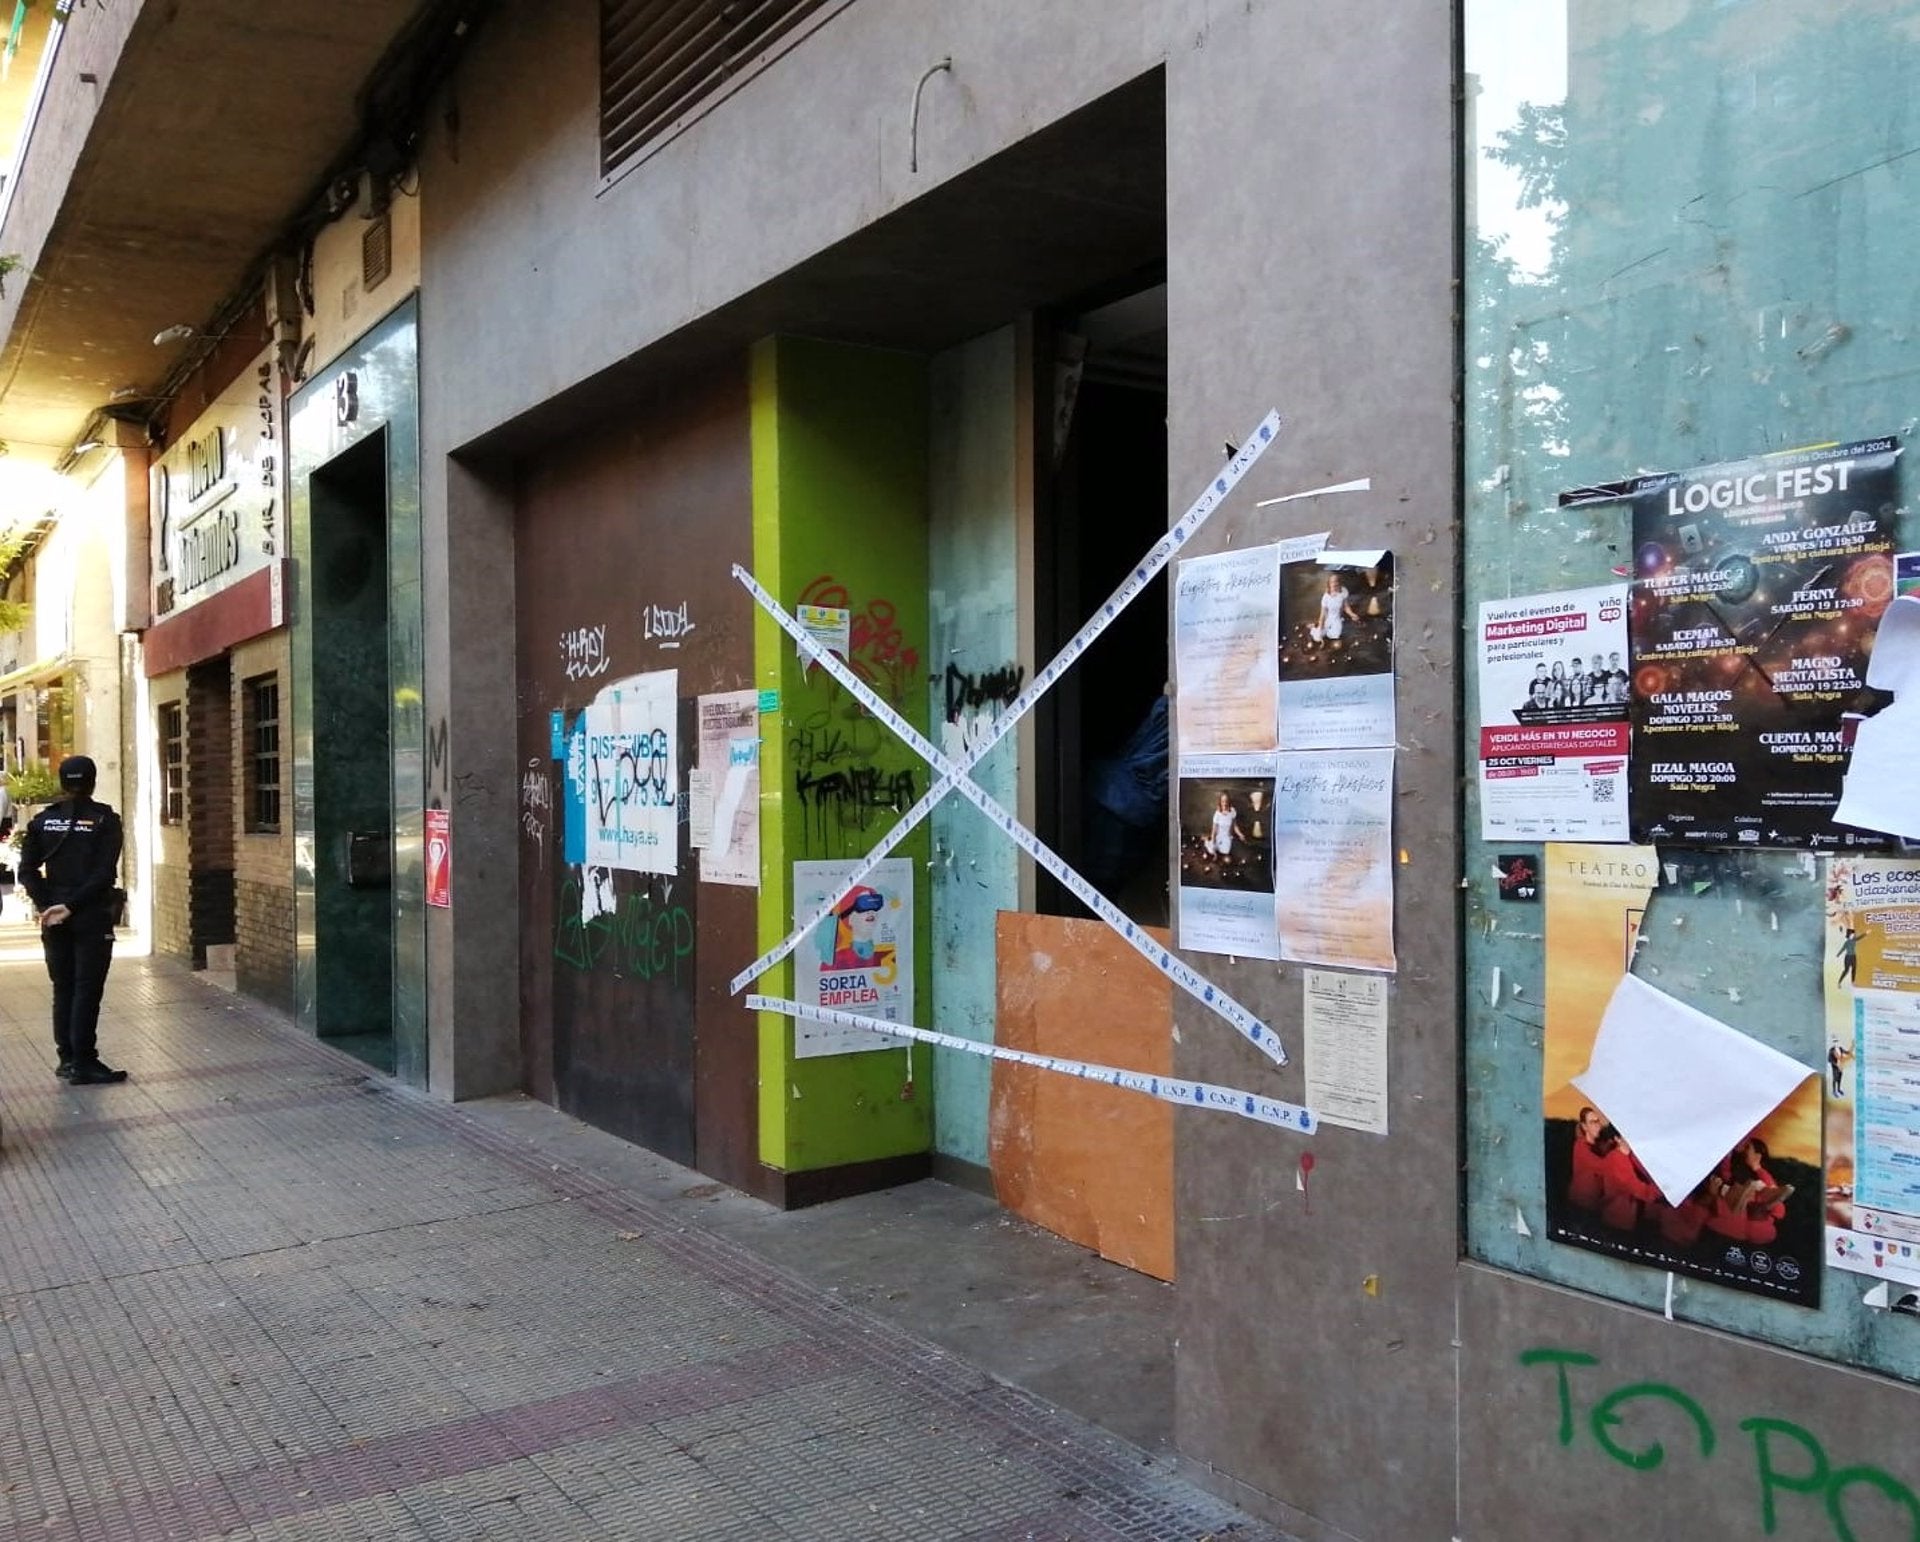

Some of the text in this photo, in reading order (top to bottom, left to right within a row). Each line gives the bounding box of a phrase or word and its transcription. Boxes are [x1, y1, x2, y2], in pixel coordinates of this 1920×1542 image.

[1811, 445, 1850, 463] Octubre
[1850, 443, 1865, 456] del
[1865, 440, 1893, 455] 2024
[1667, 474, 1768, 516] LOGIC
[1776, 460, 1856, 500] FEST
[1762, 530, 1800, 546] ANDY
[1773, 535, 1866, 554] VIERNES 18 19:30
[1864, 541, 1891, 553] Rioja
[1643, 574, 1689, 588] TUPPER
[1690, 569, 1734, 583] MAGIC
[1653, 585, 1691, 597] VIERNES
[1693, 583, 1705, 593] 18
[1791, 587, 1838, 603] FERNY
[1817, 600, 1831, 610] 19
[1834, 598, 1864, 610] 17:30
[1487, 602, 1576, 621] Vuelve el evento de
[1791, 610, 1843, 621] Sala Negra
[1486, 615, 1585, 638] Marketing Digital
[1672, 627, 1720, 641] ICEMAN
[1487, 643, 1507, 653] para
[1507, 637, 1559, 651] particulares
[1709, 637, 1737, 648] 19:30
[1487, 650, 1545, 664] profesionales
[1791, 656, 1842, 670] MAGNO
[1772, 667, 1856, 683] MENTALISTA
[1817, 681, 1831, 690] 19
[1832, 680, 1862, 690] 22:30
[1650, 690, 1733, 704] GALA MAGOS
[1791, 691, 1843, 702] Sala Negra
[1663, 702, 1719, 715] NOVELES
[1649, 713, 1734, 726] DOMINGO 20 12:30
[1489, 728, 1618, 744] VENDE MÁS EN TU NEGOCIO
[1759, 732, 1811, 745] CUENTA
[1490, 742, 1531, 753] APLICANDO
[1579, 739, 1618, 749] DIGITALES
[1770, 744, 1818, 754] DOMINGO
[1820, 743, 1834, 753] 20
[1499, 757, 1517, 767] OCT
[1518, 755, 1554, 766] VIERNES
[1791, 753, 1844, 764] Sala Negra
[1651, 762, 1736, 774] ITZAL MAGOA
[1650, 774, 1737, 783] DOMINGO 20 20:00
[1567, 861, 1647, 878] TEATRO
[1851, 869, 1920, 886] Los ecos
[819, 975, 868, 991] SORIA
[819, 989, 879, 1007] EMPLEA
[1208, 1090, 1239, 1107] C.N.P.
[1260, 1103, 1293, 1123] C.N.P.
